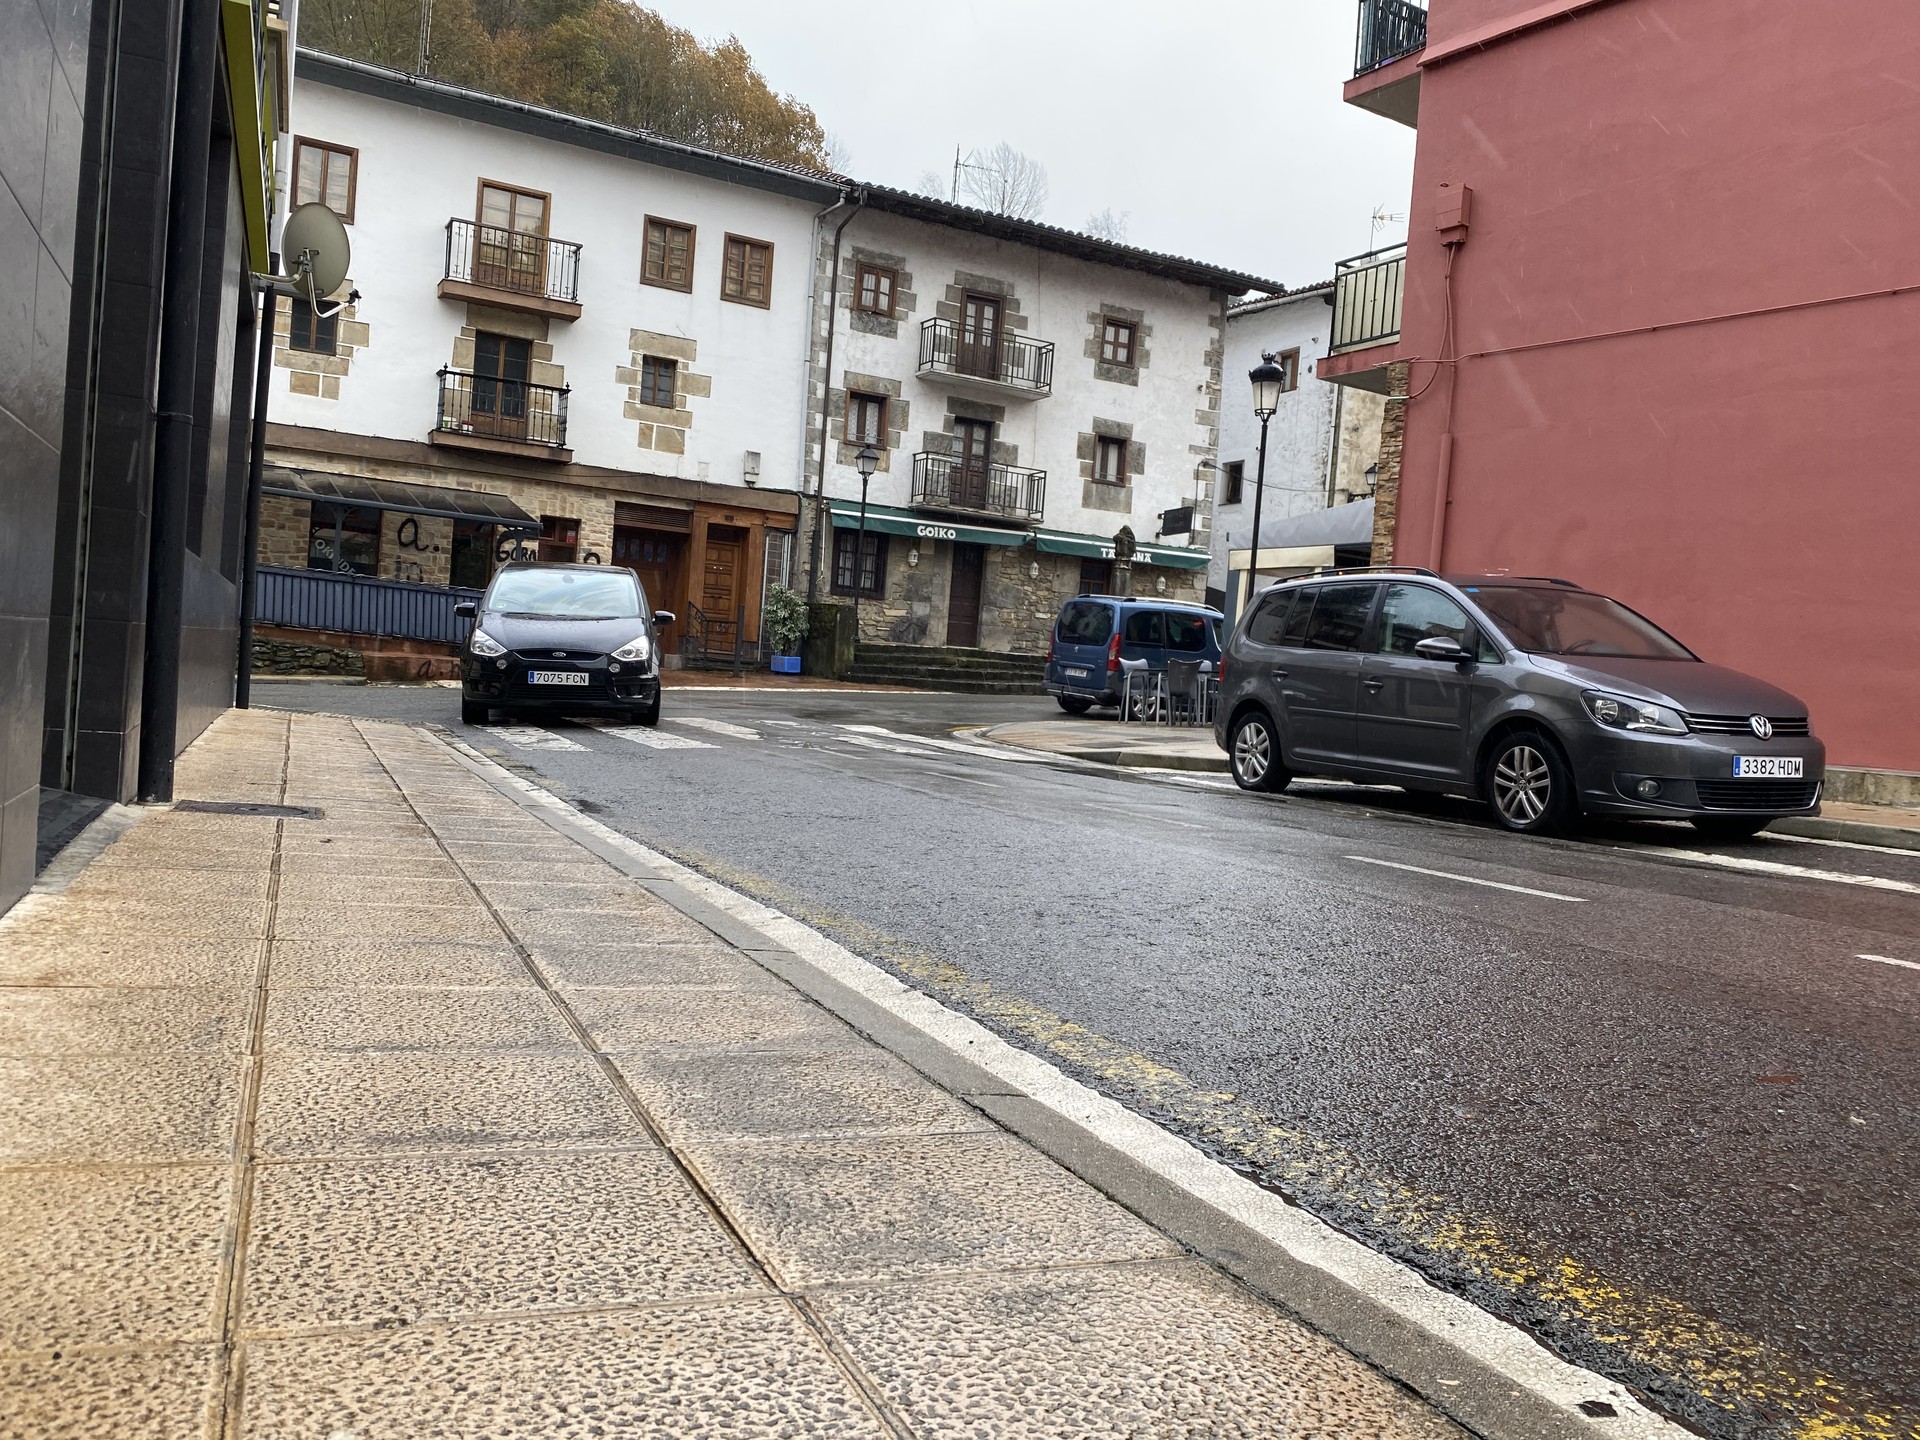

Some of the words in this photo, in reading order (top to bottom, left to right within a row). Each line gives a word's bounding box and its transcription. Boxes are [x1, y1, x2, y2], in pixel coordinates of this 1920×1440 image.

[1101, 548, 1152, 563] TANA
[536, 673, 563, 683] 7075
[565, 674, 586, 684] FCN
[1743, 759, 1775, 775] 3382
[1778, 760, 1801, 776] HDM
